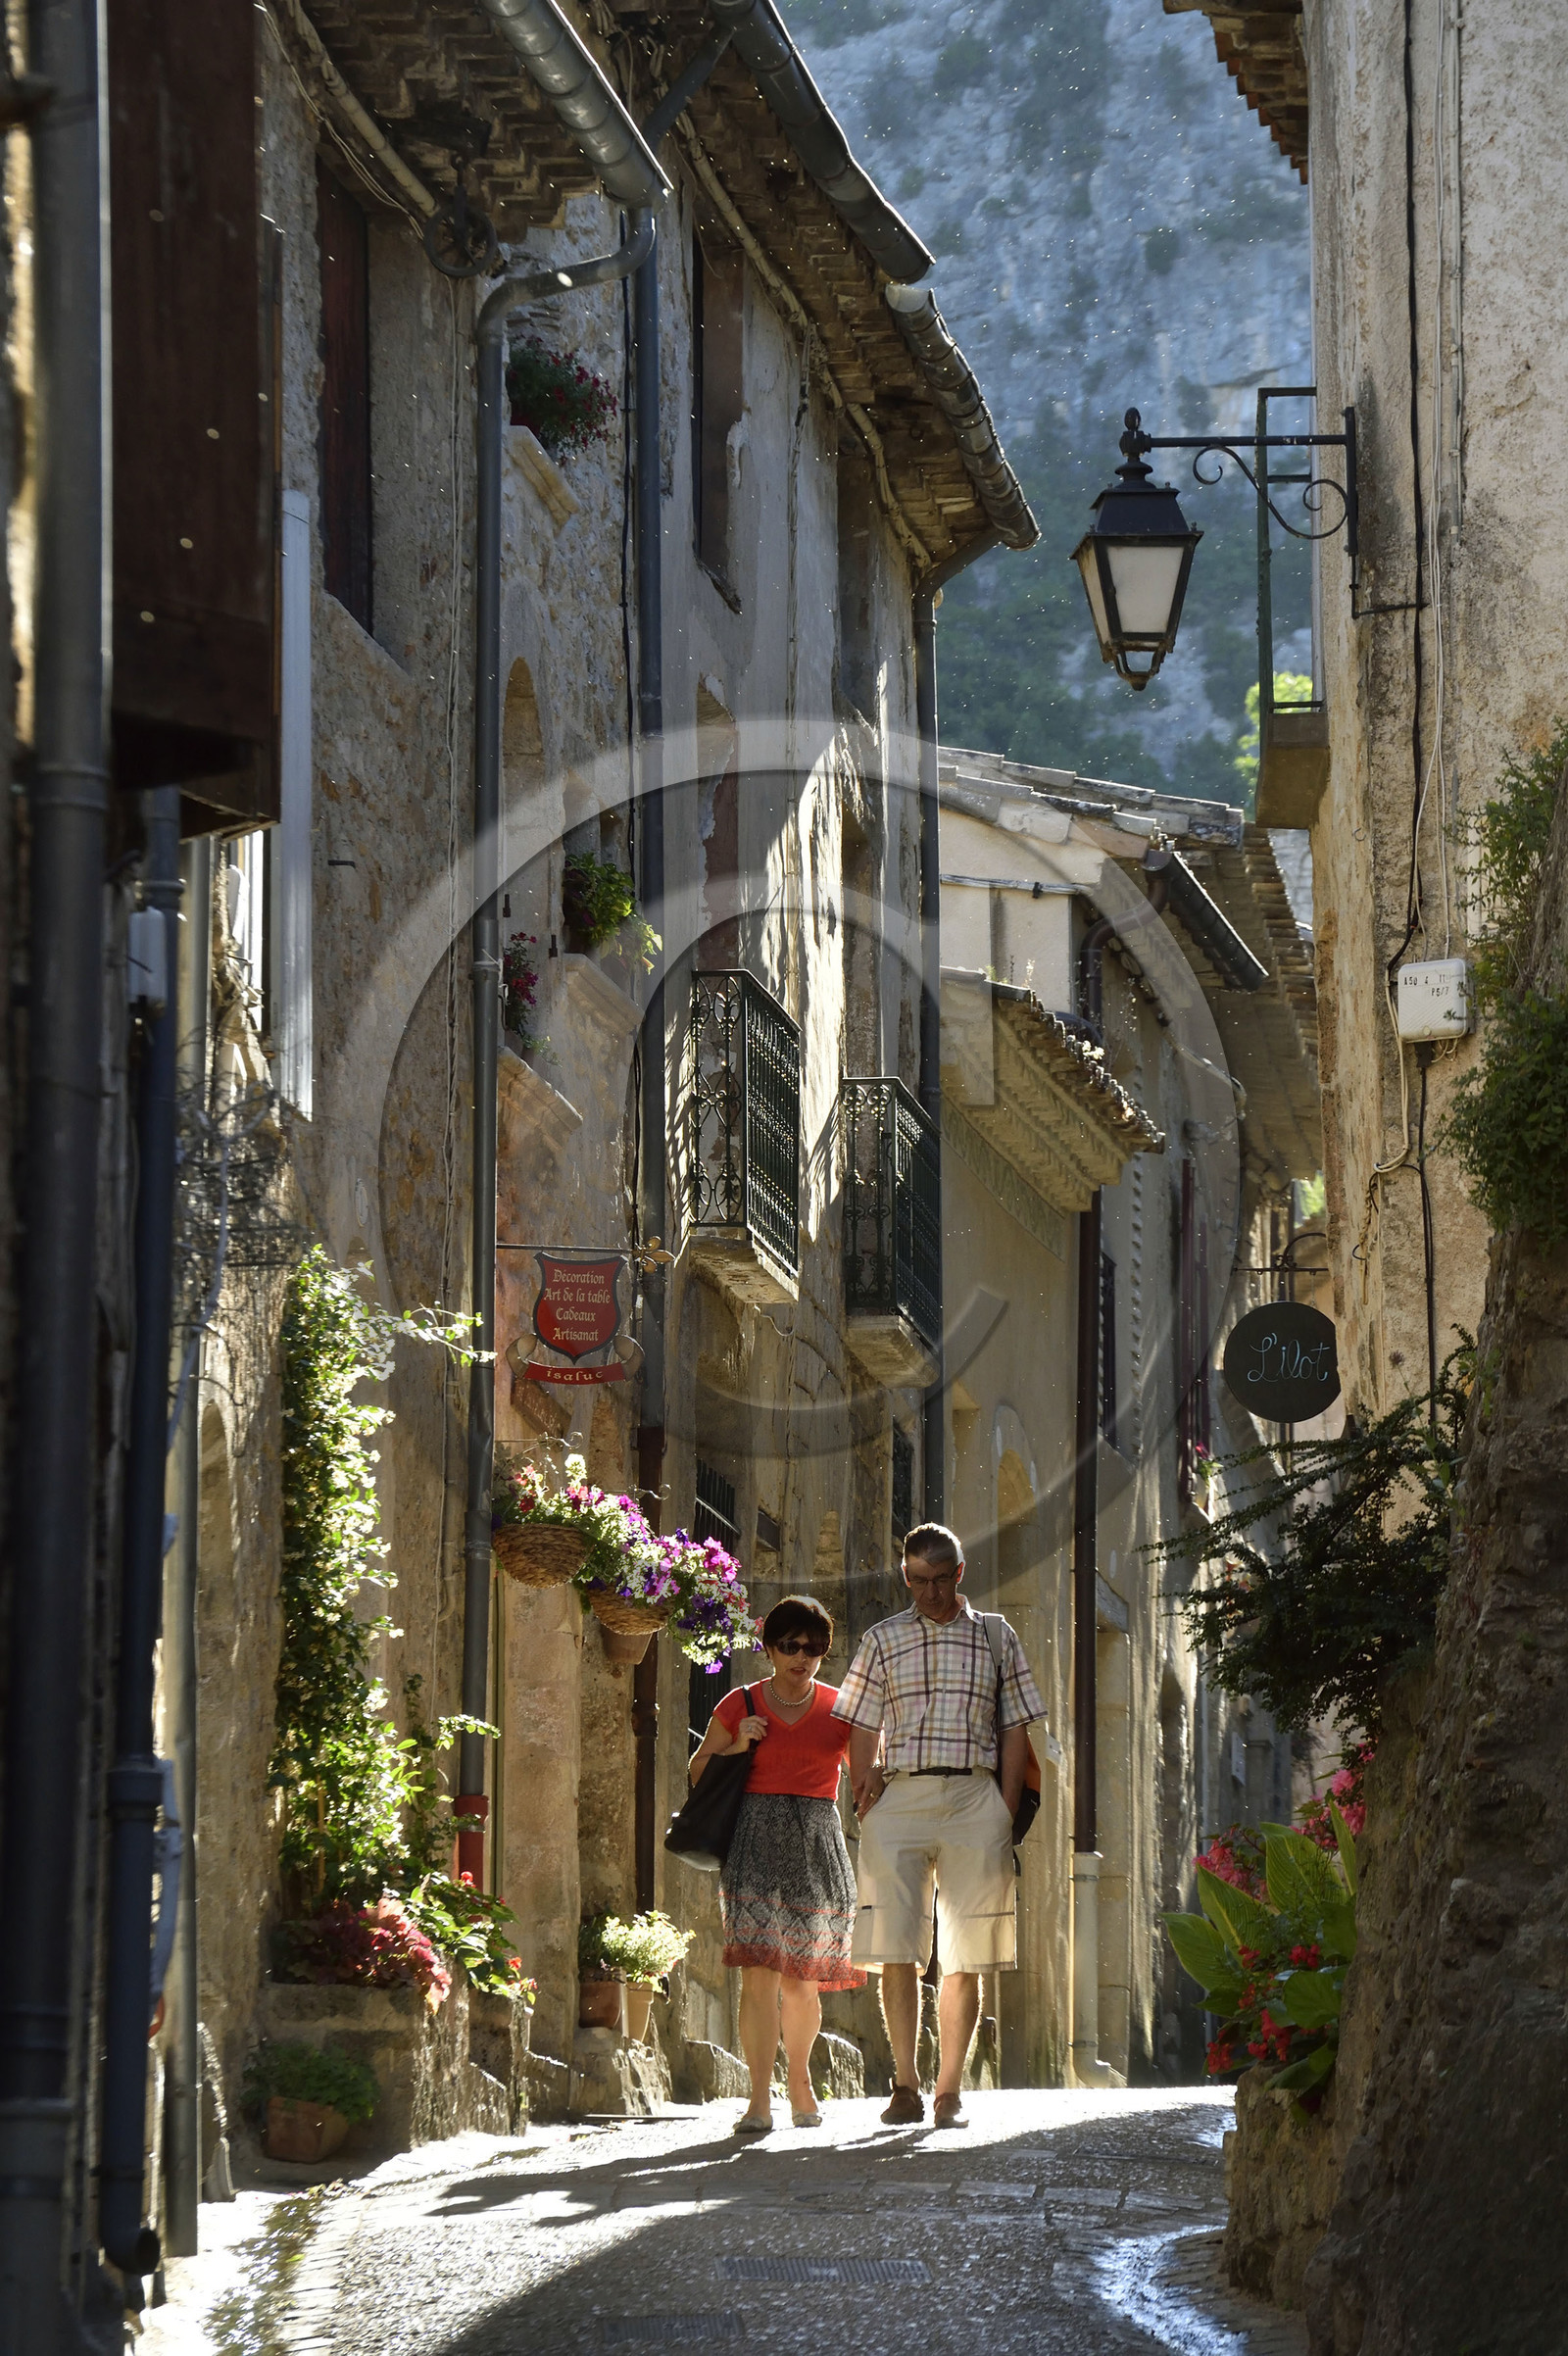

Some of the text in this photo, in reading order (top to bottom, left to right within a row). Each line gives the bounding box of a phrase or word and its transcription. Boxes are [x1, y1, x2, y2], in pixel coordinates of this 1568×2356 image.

[553, 1268, 605, 1285] Décoration
[544, 1287, 611, 1304] Art de la table
[556, 1306, 596, 1322] Cadeaux
[553, 1327, 599, 1342] Artisanat
